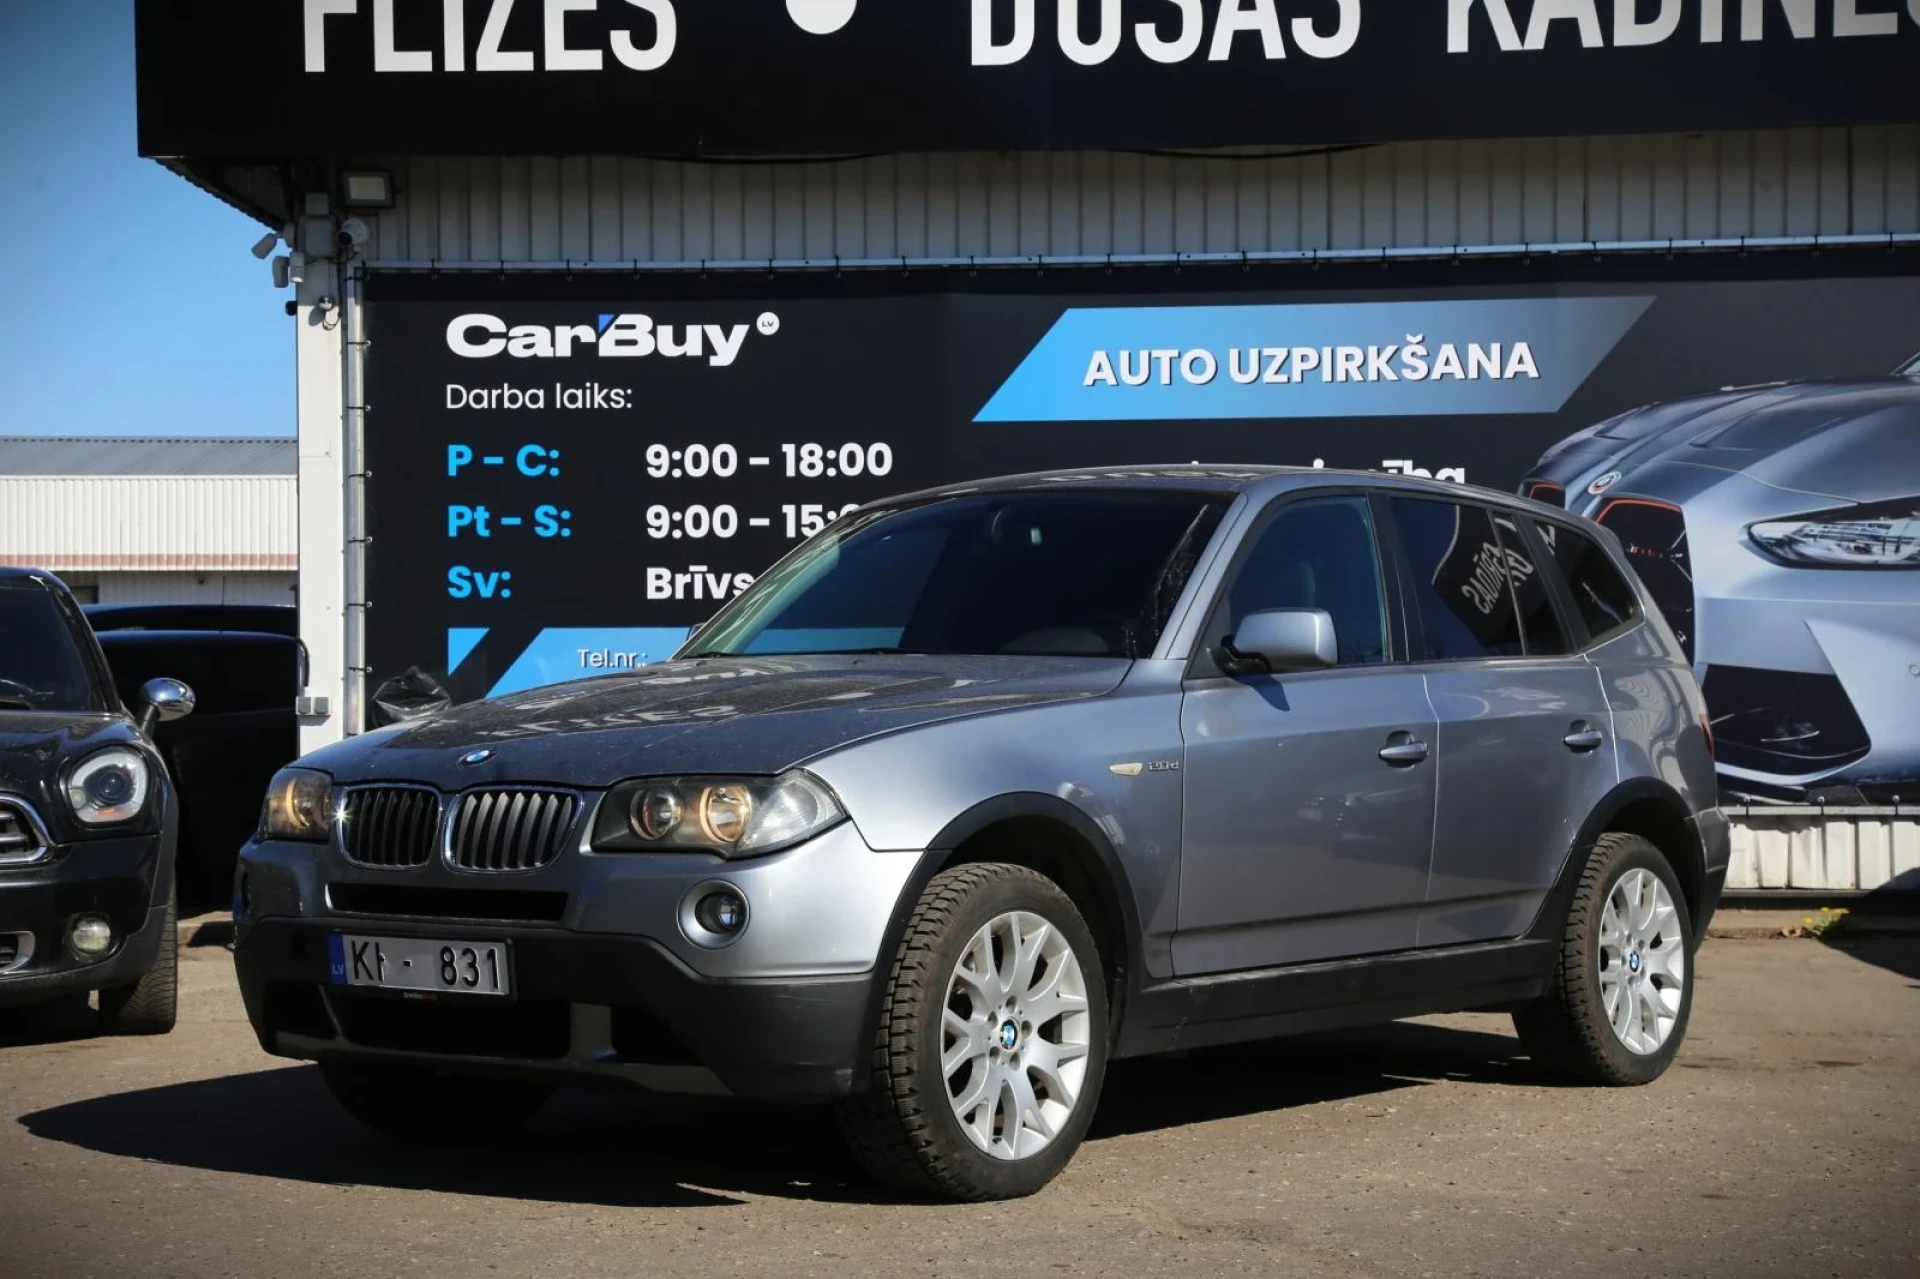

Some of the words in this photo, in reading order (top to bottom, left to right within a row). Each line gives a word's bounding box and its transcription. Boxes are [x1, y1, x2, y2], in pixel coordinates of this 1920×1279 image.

[446, 313, 751, 367] CarBuy
[1085, 349, 1216, 386] AUTO
[1229, 334, 1540, 384] UZPIRKŠANA
[446, 383, 544, 410] Darba
[555, 382, 633, 410] laiks:
[447, 445, 473, 477] P
[515, 444, 560, 477] C:
[645, 443, 738, 479] 9:00
[781, 442, 893, 478] 18:00
[447, 505, 491, 538] Pt
[533, 504, 572, 538] S:
[645, 504, 738, 539] 9:00
[447, 566, 512, 599] Sv:
[331, 964, 345, 975] LV
[439, 946, 500, 990] 831
